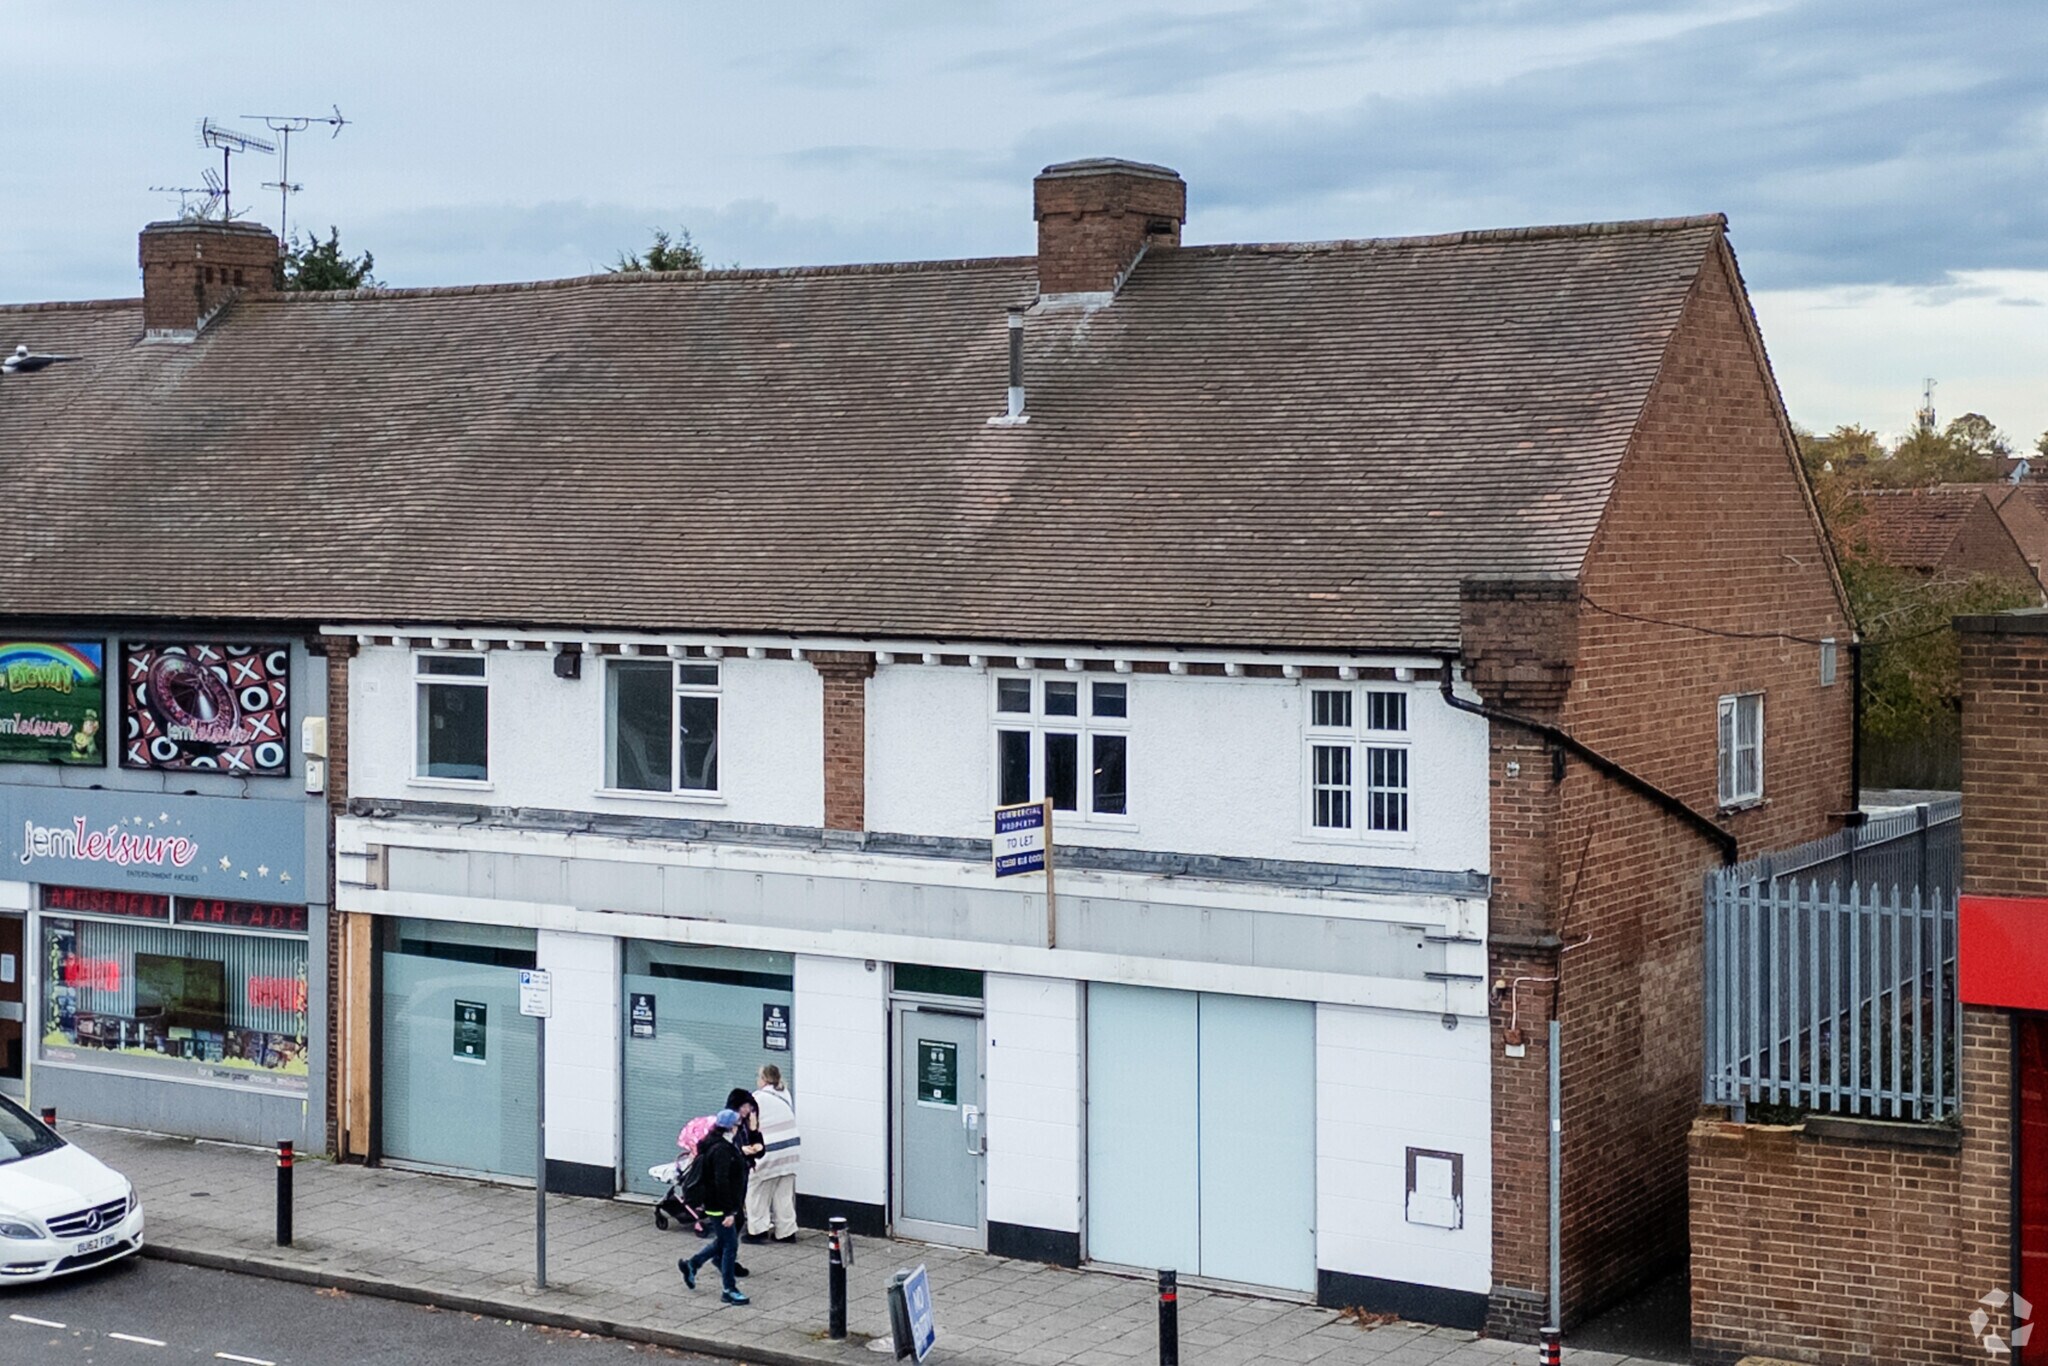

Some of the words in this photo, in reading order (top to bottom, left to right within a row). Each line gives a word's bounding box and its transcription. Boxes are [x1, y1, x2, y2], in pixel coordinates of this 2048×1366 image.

[997, 806, 1041, 820] COMMERCIAL
[1001, 819, 1037, 832] PROPERTY
[20, 815, 198, 866] jemleisure
[1007, 837, 1017, 849] TO
[1019, 835, 1034, 848] LET
[51, 886, 168, 918] AMUSEMENT
[191, 899, 303, 931] ARCADE
